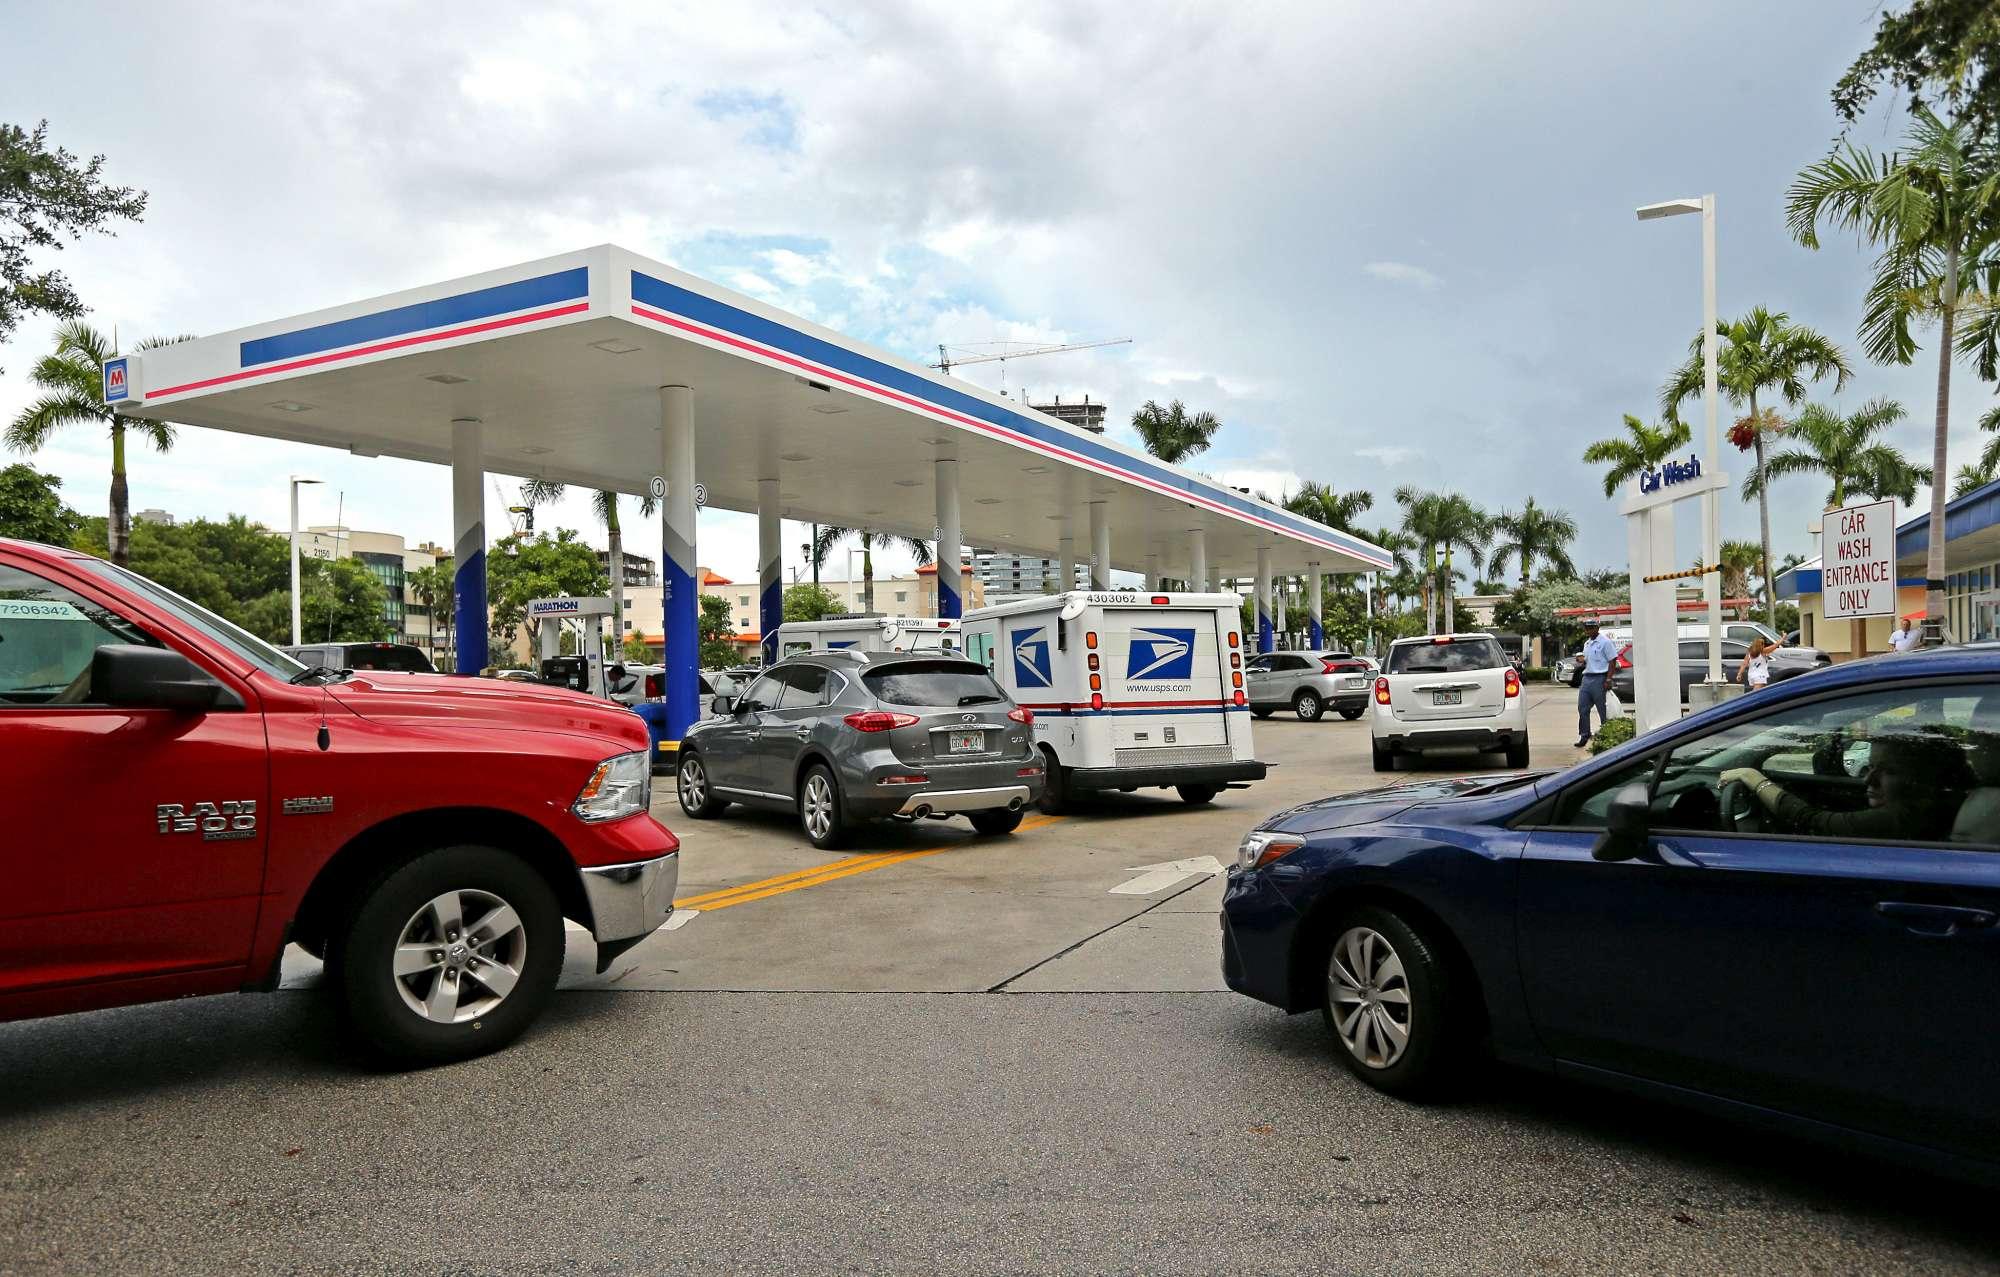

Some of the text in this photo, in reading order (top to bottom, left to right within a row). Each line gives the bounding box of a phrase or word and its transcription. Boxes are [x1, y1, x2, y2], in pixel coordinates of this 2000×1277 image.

[1640, 453, 1701, 494] Car Wash
[1841, 513, 1865, 535] CAR
[1838, 537, 1871, 561] WASH
[1826, 561, 1889, 588] ENTRANCE
[534, 601, 578, 611] MARATHON
[1087, 594, 1136, 603] 4303062
[1840, 589, 1870, 611] ONLY
[0, 604, 70, 616] 7206342
[1126, 684, 1191, 694] www.usps.com
[157, 800, 256, 818] RAM
[157, 815, 256, 833] 1500
